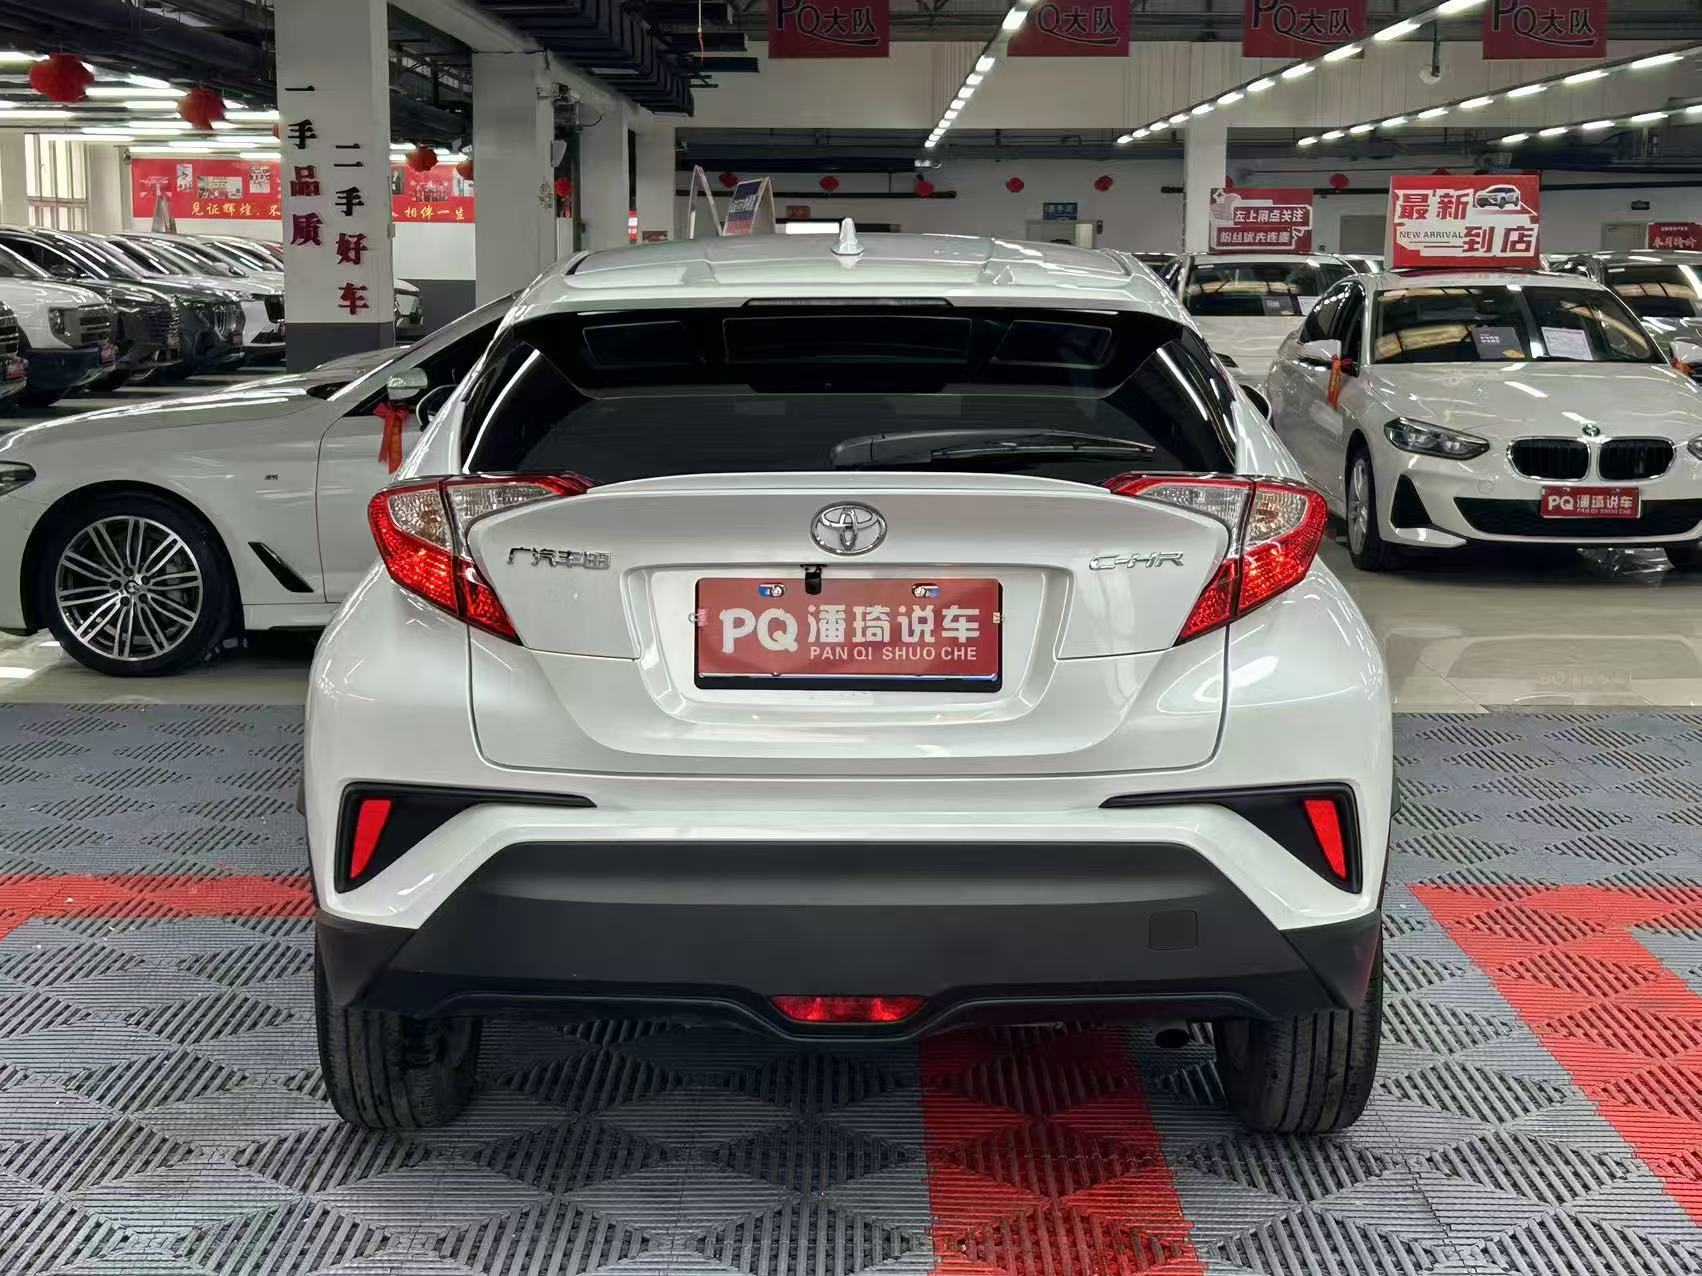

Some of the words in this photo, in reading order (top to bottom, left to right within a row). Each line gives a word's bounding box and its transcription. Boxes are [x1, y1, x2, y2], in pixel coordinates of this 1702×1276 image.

[284, 85, 323, 246] 一手品质
[1398, 192, 1470, 220] 最新
[333, 142, 370, 315] 二手好车
[1399, 231, 1421, 239] NEW
[1424, 231, 1464, 239] ARRIVAL
[1462, 224, 1535, 253] 到店
[1548, 494, 1573, 511] PQ
[507, 548, 611, 570] 广汽丰田
[1089, 551, 1184, 571] C-HR
[719, 608, 799, 654] PQ
[808, 605, 981, 643] 潘琦说车
[810, 646, 848, 660] PAN
[854, 646, 872, 660] QI
[882, 646, 935, 660] SHUO
[940, 646, 977, 660] CHE
